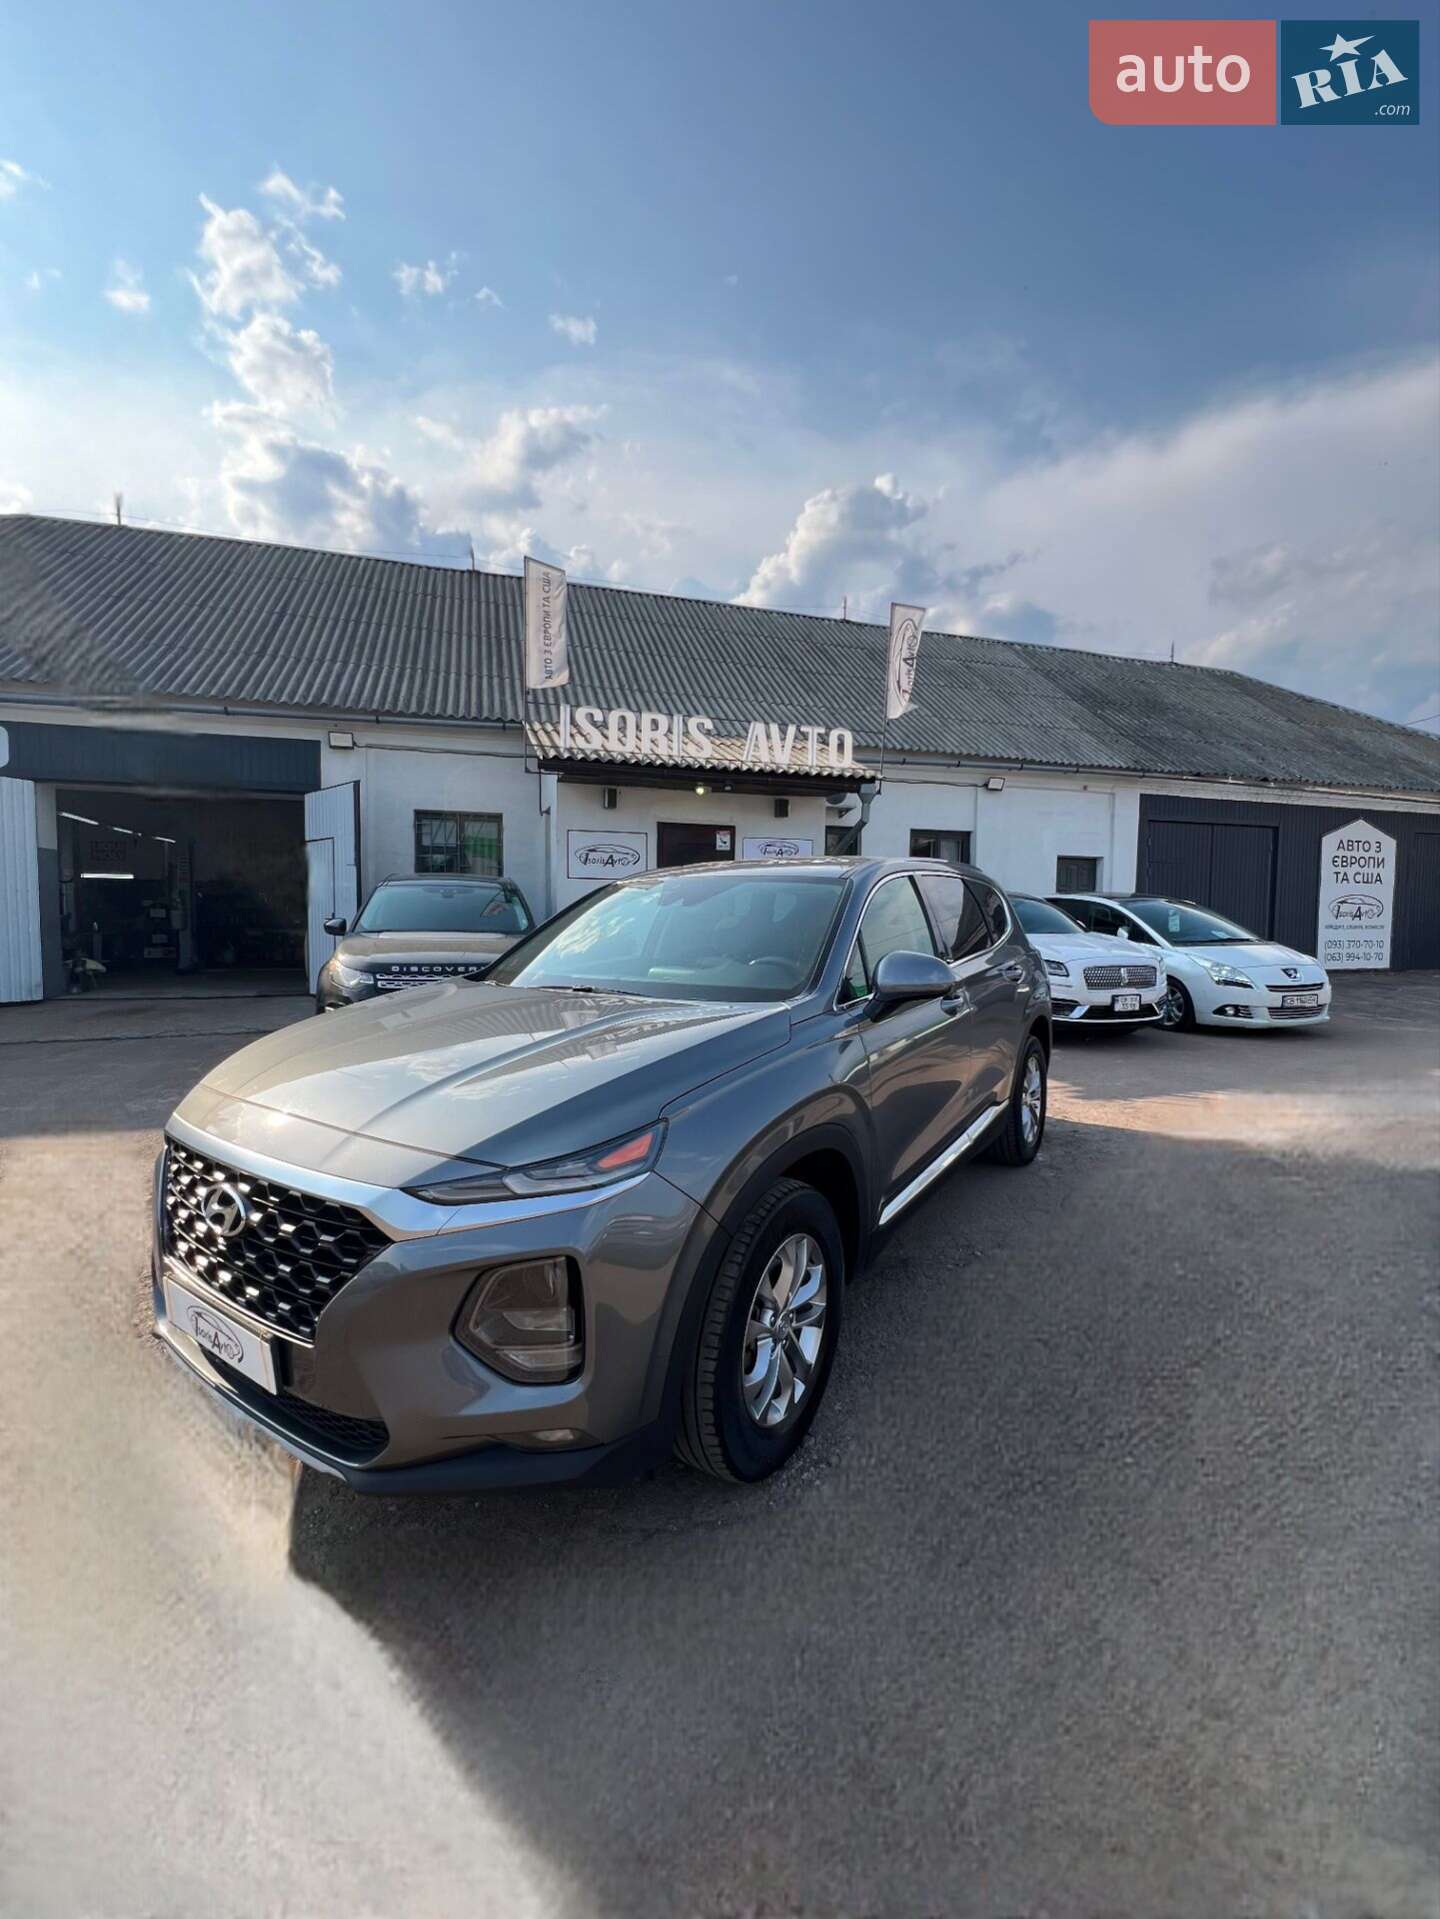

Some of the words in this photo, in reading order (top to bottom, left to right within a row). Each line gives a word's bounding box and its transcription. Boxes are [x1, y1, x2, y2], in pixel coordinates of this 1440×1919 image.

[560, 703, 713, 758] ISORIS
[743, 721, 853, 769] AVTO
[1336, 839, 1371, 852] АВТО
[1332, 855, 1385, 869] ЄВРОПИ
[1333, 871, 1350, 884] ТА
[1353, 872, 1383, 885] США
[1324, 940, 1344, 950] (093)
